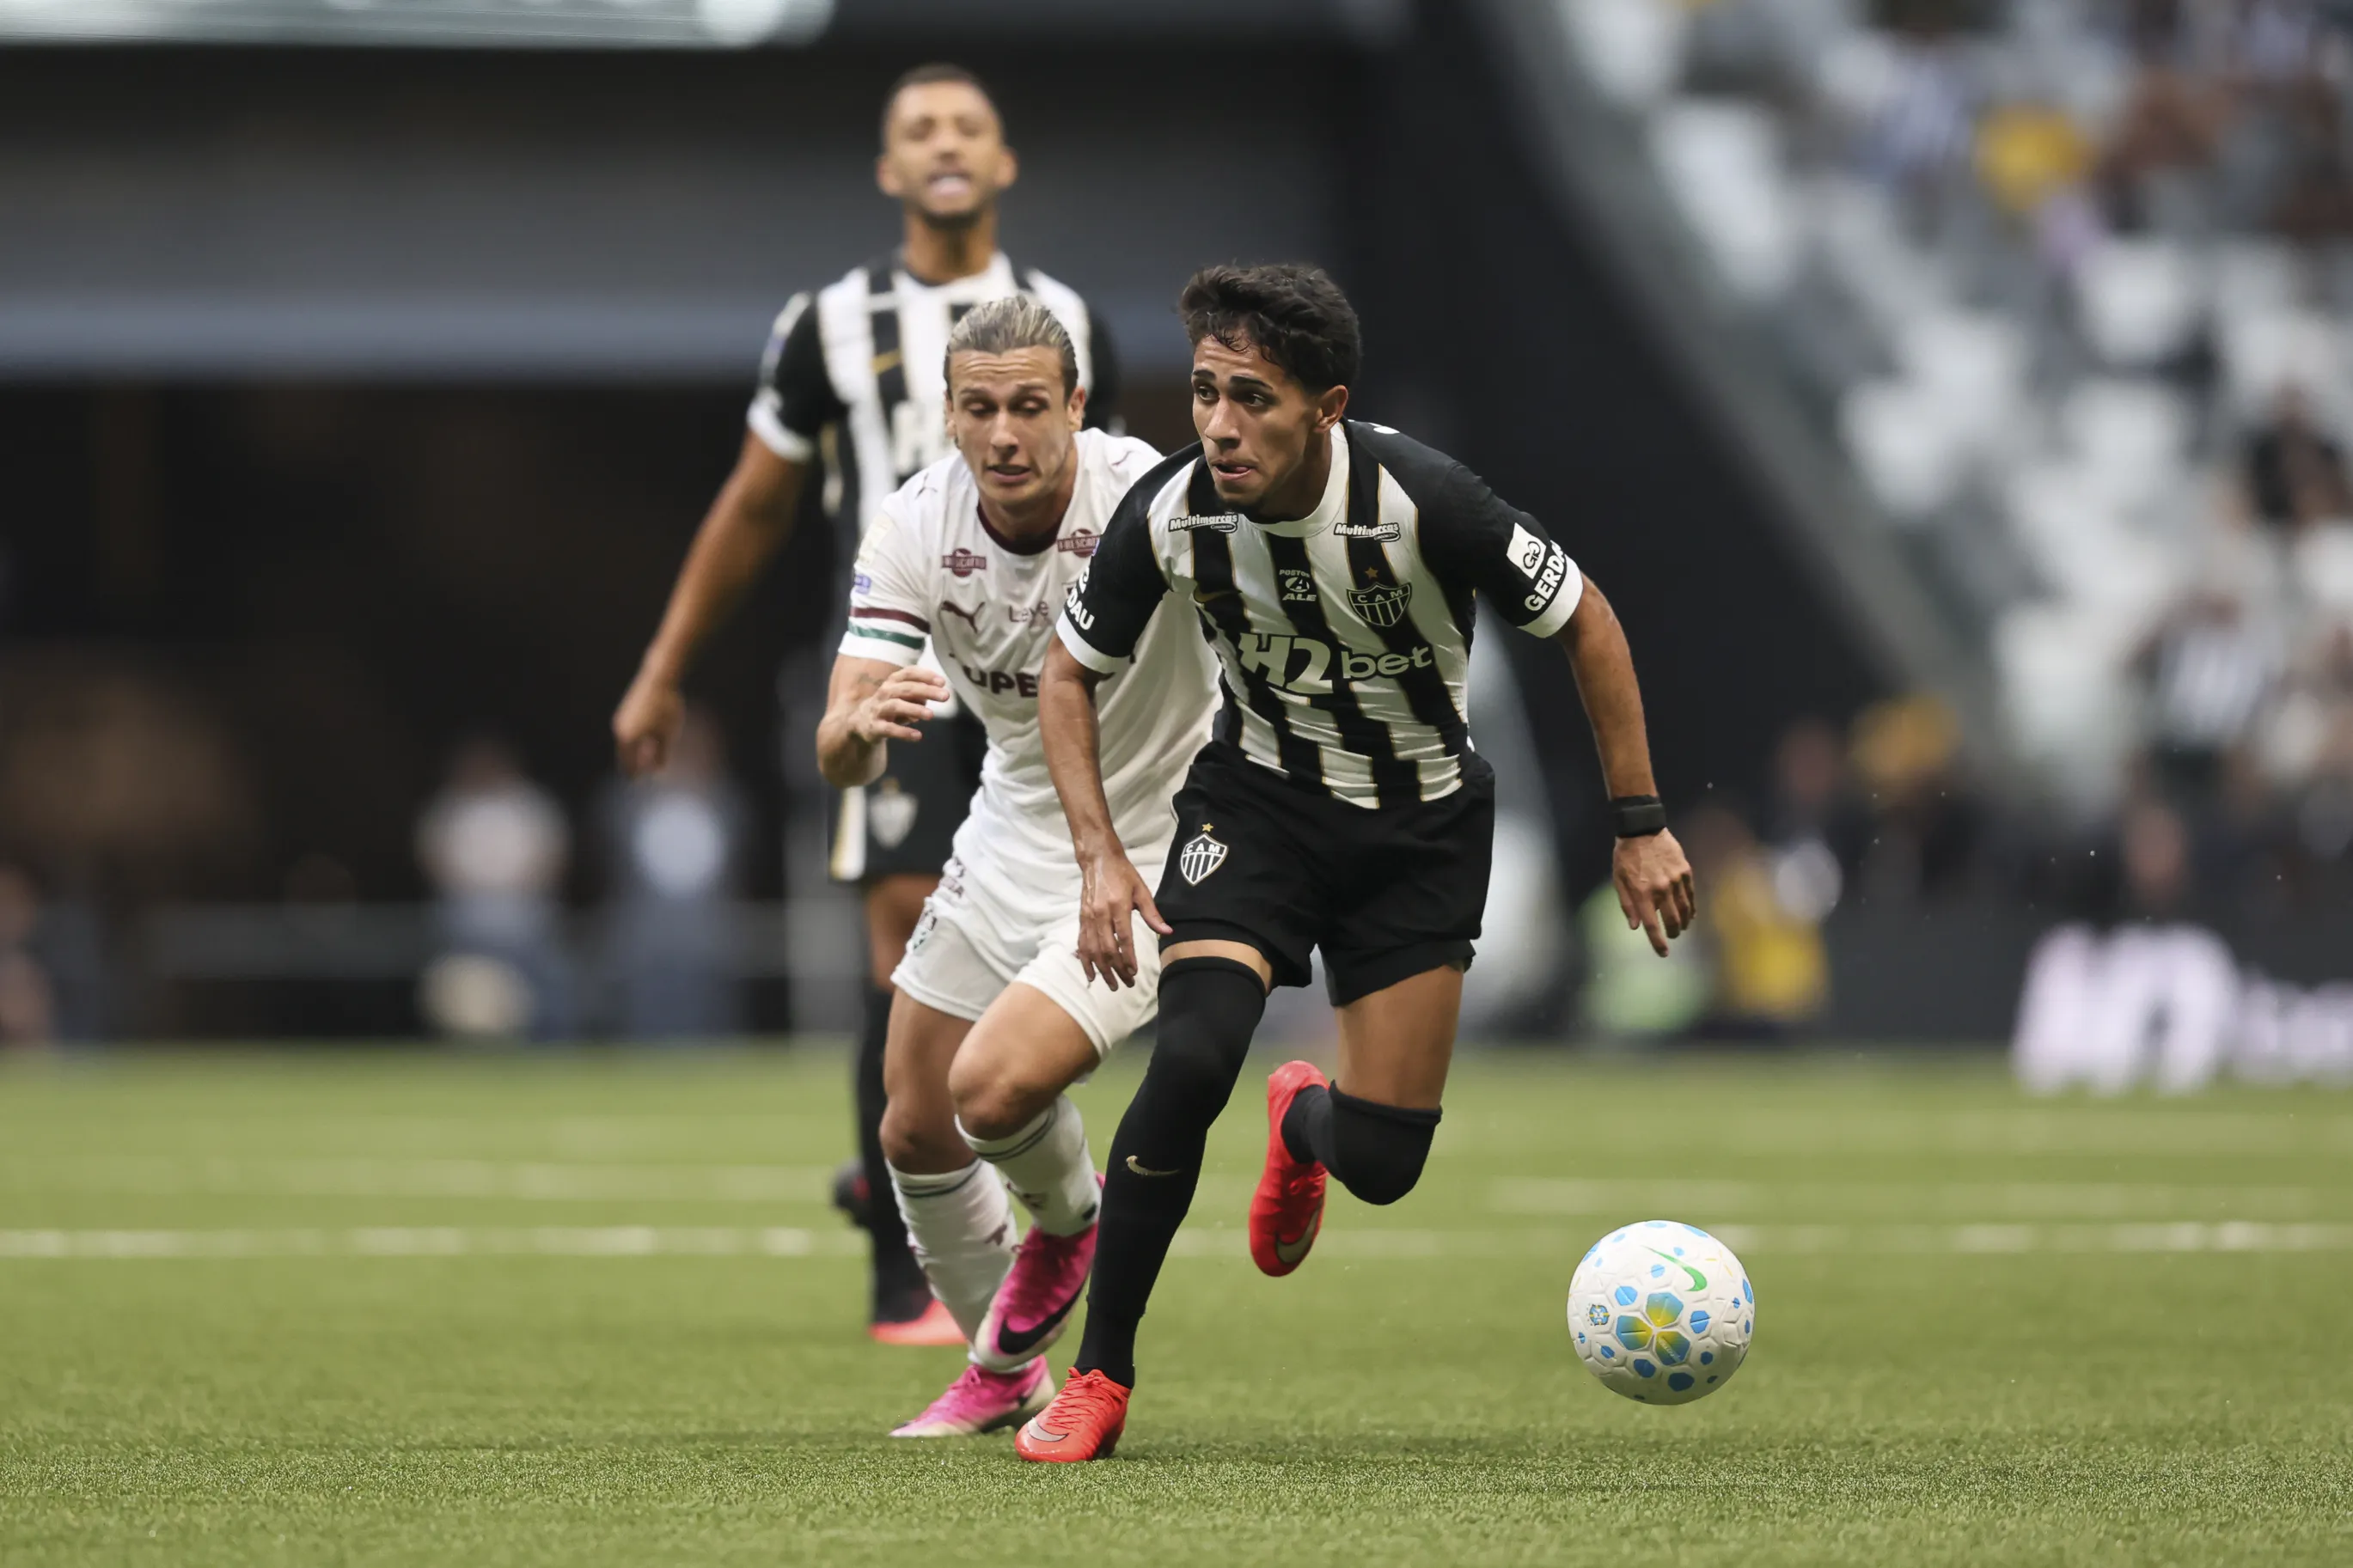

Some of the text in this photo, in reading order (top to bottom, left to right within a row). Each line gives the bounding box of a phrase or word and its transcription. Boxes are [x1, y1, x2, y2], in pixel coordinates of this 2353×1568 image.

[1169, 513, 1238, 531] Multimarcas
[1524, 540, 1566, 611] GERDA
[1281, 593, 1317, 601] ALE
[1357, 589, 1403, 603] CAM
[1186, 843, 1220, 853] CAM
